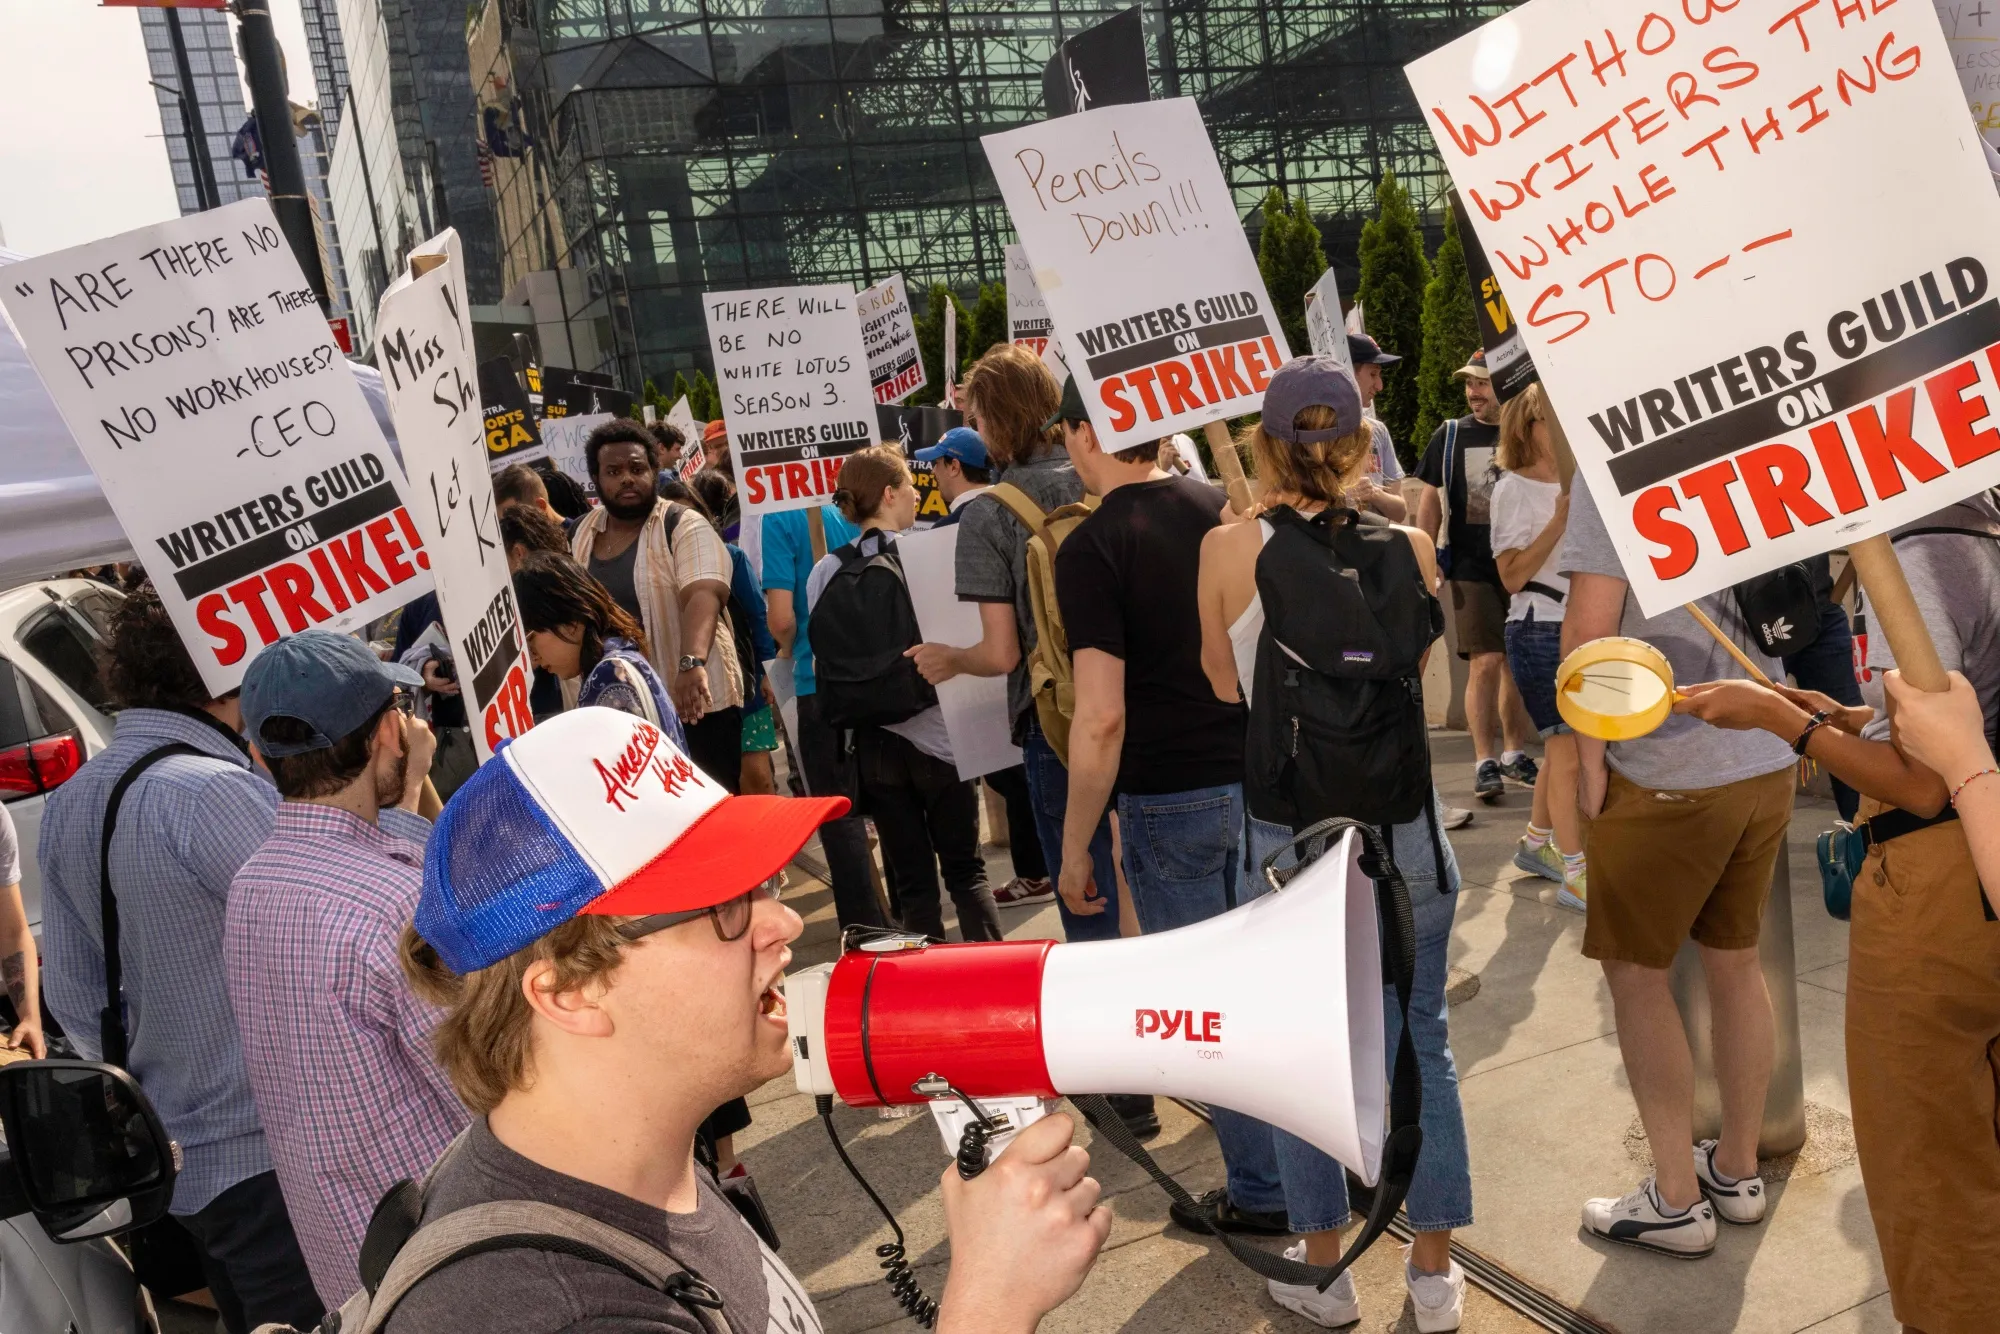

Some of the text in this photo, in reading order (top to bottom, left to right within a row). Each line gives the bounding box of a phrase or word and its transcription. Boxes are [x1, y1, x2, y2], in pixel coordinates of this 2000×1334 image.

[1014, 130, 1161, 211] Pencils
[1494, 31, 1922, 281] WHOLE THING
[1071, 179, 1210, 254] Down!!!
[139, 237, 233, 282] THERE
[242, 223, 280, 257] NO
[711, 297, 847, 323] THERE WILL
[892, 321, 901, 332] A
[1013, 318, 1054, 330] WRITER
[1076, 290, 1259, 356] WRITERS GUILD
[65, 286, 318, 390] PRISONS? ARE THERE
[718, 329, 802, 353] BE NO
[1173, 331, 1200, 353] ON
[723, 355, 850, 380] WHITE LOTUS
[896, 347, 916, 366] GUILD
[1586, 255, 1990, 455] WRITERS GUILD
[733, 391, 810, 415] SEASON
[1775, 380, 1833, 428] ON
[100, 406, 157, 450] NO
[737, 420, 869, 451] WRITERS GUILD
[801, 445, 820, 459] ON
[156, 452, 386, 569] WRITERS GUILD
[285, 519, 319, 552] ON
[195, 506, 431, 667] STRIKE!
[1761, 623, 1774, 646] adidas
[1135, 1008, 1222, 1042] PYLE
[988, 1107, 1001, 1116] USB
